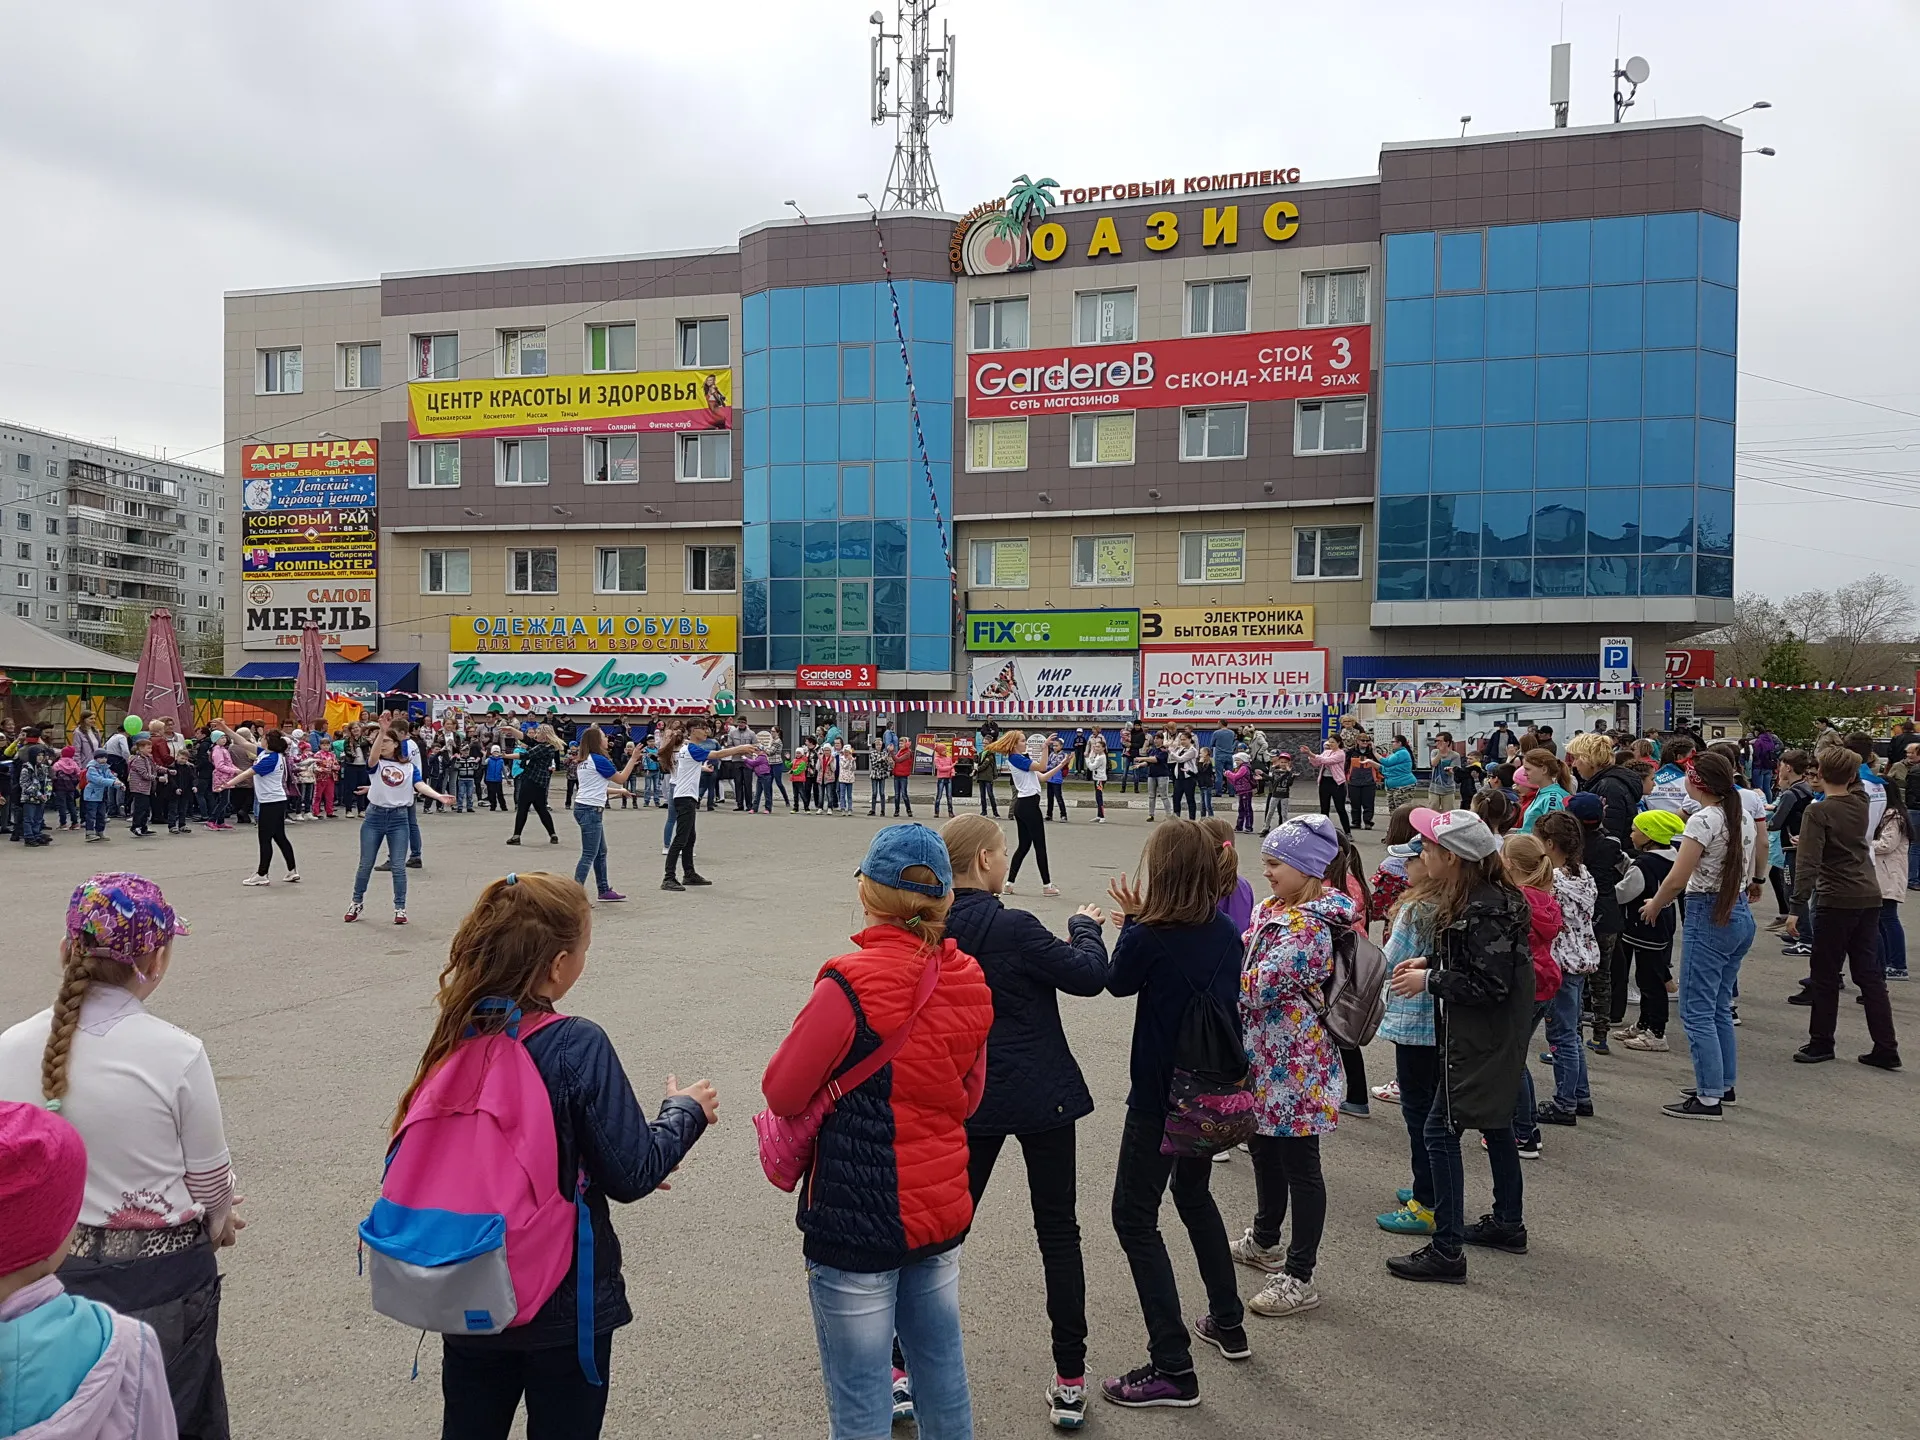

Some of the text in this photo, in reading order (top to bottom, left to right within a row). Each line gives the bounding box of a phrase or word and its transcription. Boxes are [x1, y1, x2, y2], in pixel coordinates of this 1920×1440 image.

[1060, 167, 1300, 205] ТОРГОВЫЙ КОМПЛЕКС
[949, 197, 1006, 272] СОЛНЕЧНЫЙ
[1032, 201, 1299, 262] ОАЗИС
[1104, 303, 1113, 336] ЮРИСТ
[1258, 345, 1314, 364] СТОК
[1329, 336, 1352, 370] 3
[976, 352, 1154, 395] GarderoB
[1165, 364, 1313, 390] СЕКОНД-ХЕНД
[1320, 373, 1360, 387] ЭТАЖ
[428, 382, 697, 413] ЦЕНТР КРАСОТЫ И ЗДОРОВЬЯ
[1010, 394, 1119, 410] сеть магазинов
[537, 425, 567, 433] Ногтевой
[608, 422, 636, 431] Солярий
[649, 421, 673, 429] Фитнес
[675, 419, 691, 428] клуб
[251, 441, 374, 460] АРЕНДА
[325, 458, 374, 467] 48-11-22
[293, 478, 349, 494] Детский
[278, 492, 368, 506] игровой центр
[249, 510, 369, 527] КОВРОВЫЙ РАЙ
[330, 551, 373, 559] Сибирский
[275, 559, 373, 571] КОМПЬЮТЕР
[307, 588, 371, 603] САЛОН
[247, 607, 370, 630] МЕБЕЛЬ
[1204, 610, 1304, 623] ЭЛЕКТРОНИКА
[473, 616, 709, 637] ОДЕЖДА И ОБУВЬ
[1013, 622, 1050, 636] price
[1174, 624, 1304, 637] БЫТОВАЯ ТЕХНИКА
[477, 634, 708, 652] ДЛЯ ДЕТЕЙ И ВЗРОСЛЫХ
[1191, 653, 1273, 667] МАГАЗИН
[448, 656, 667, 698] Парфюм Лидер
[800, 669, 852, 679] GarderoB
[859, 668, 868, 680] 3
[1037, 668, 1072, 681] МИР
[1158, 671, 1309, 687] ДОСТУПНЫХ ЦЕН
[1035, 683, 1123, 698] УВЛЕЧЕНИЙ
[1228, 709, 1256, 717] нибудь
[1385, 703, 1456, 716] С праздником!
